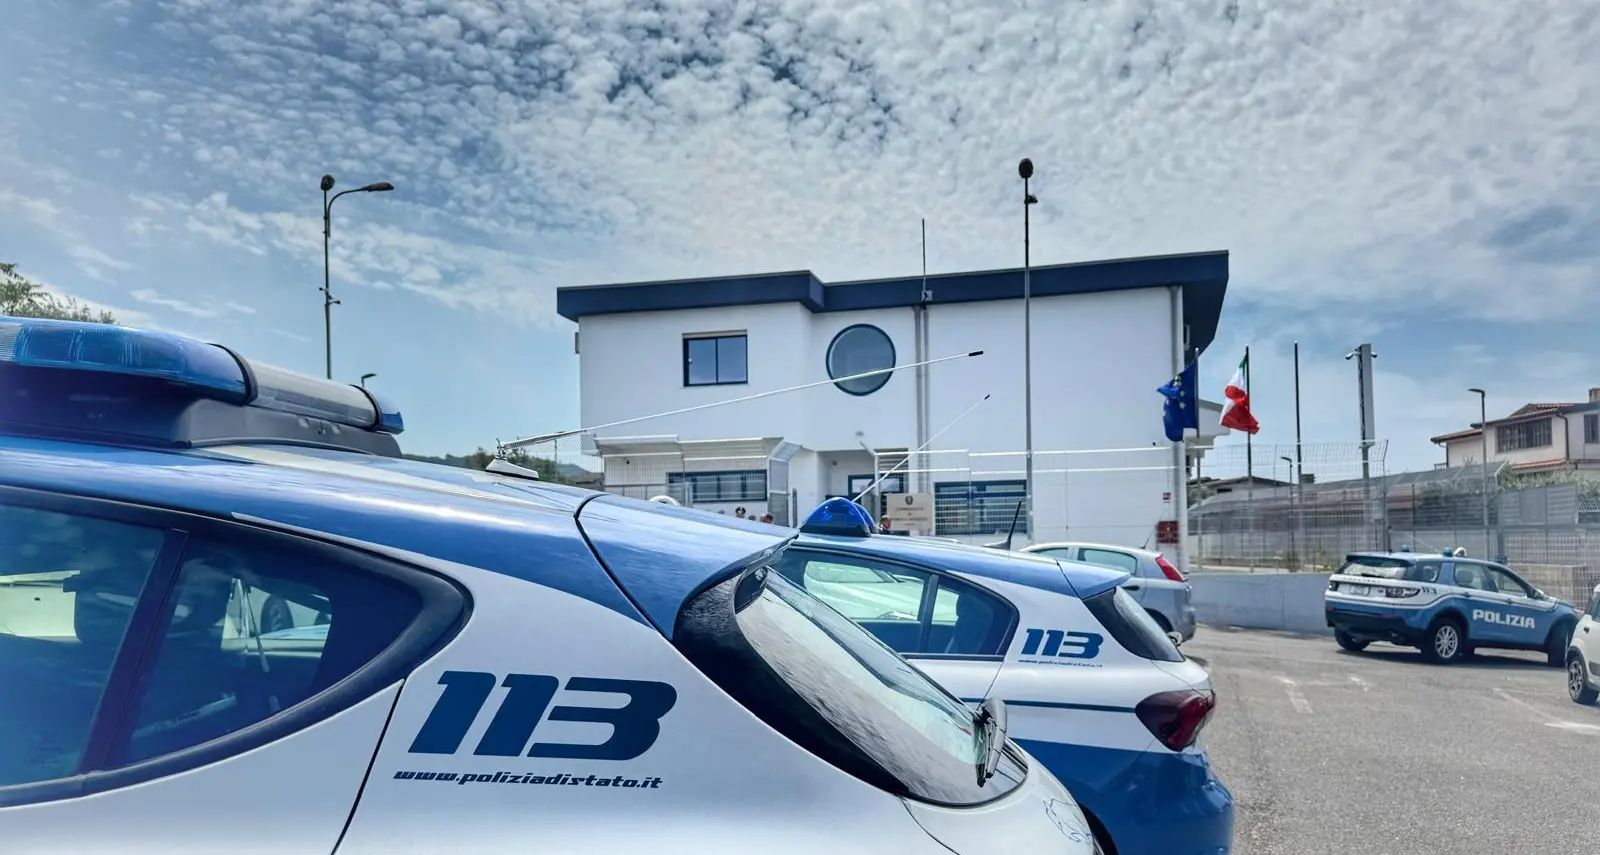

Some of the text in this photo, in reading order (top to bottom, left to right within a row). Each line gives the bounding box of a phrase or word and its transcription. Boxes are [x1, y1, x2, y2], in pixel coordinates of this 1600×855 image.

[1472, 609, 1536, 629] POLIZIA
[1021, 628, 1104, 659] 113
[408, 670, 678, 761] 113
[393, 771, 664, 789] www.poliziadistato.it
